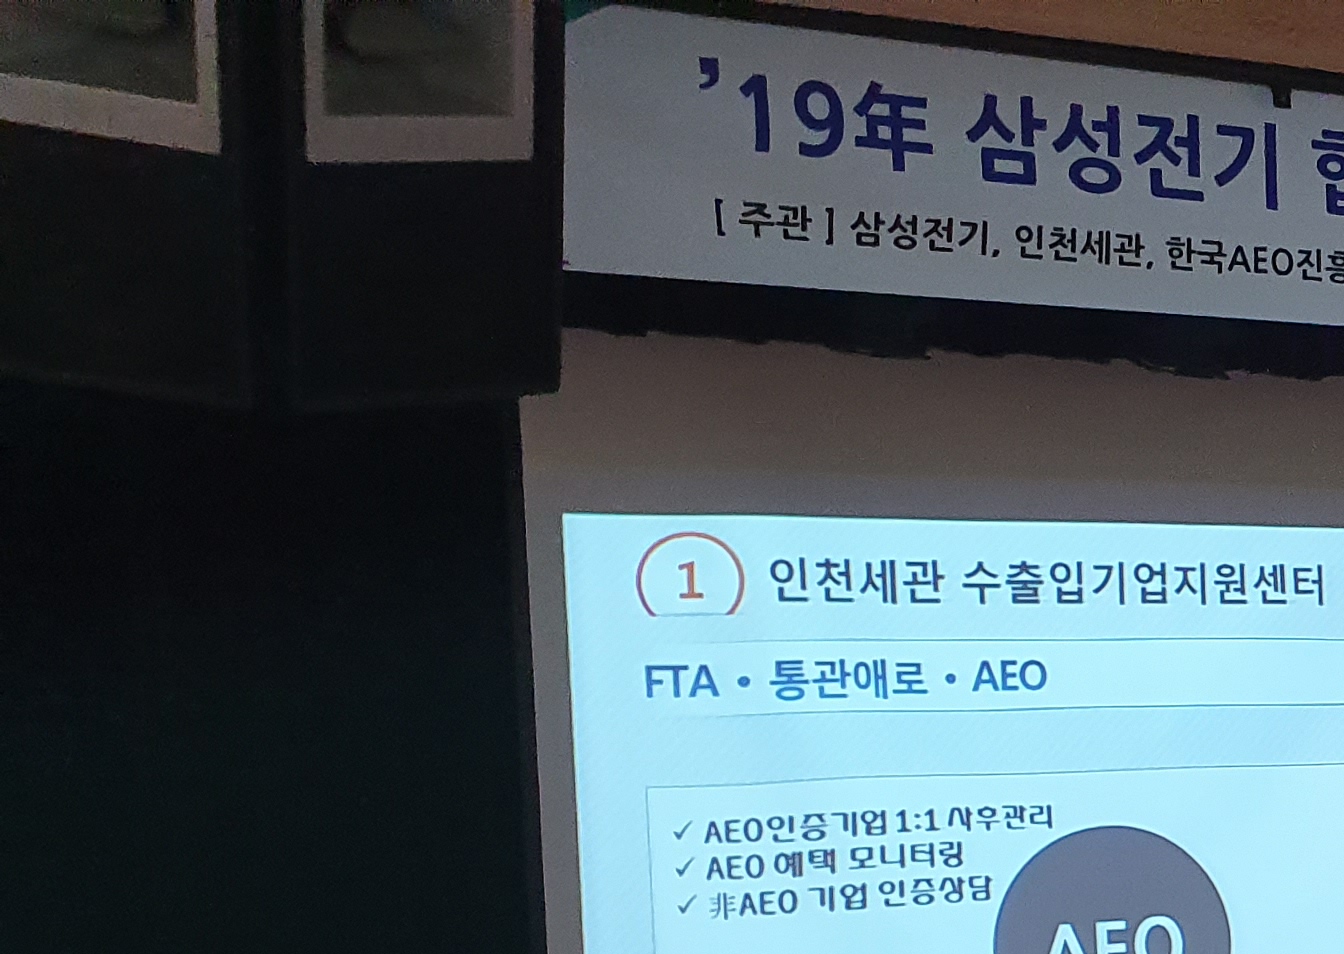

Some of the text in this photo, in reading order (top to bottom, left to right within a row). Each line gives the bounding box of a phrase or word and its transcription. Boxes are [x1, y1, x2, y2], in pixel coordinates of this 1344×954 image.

[965, 93, 1280, 212] 삼성전기
[850, 212, 1001, 261] 삼성전기,
[1015, 223, 1154, 271] 인천세관,
[677, 557, 1326, 606] 1 인천세관 수출입기업지원센터
[644, 659, 1048, 701] FTA 통관애로 AEO
[704, 804, 1053, 844] AEO인증기업 1:1 사후관리
[706, 855, 764, 880] AEO
[849, 841, 964, 870] 모니터링
[807, 882, 867, 912] 기업
[878, 875, 993, 907] 인증상담
